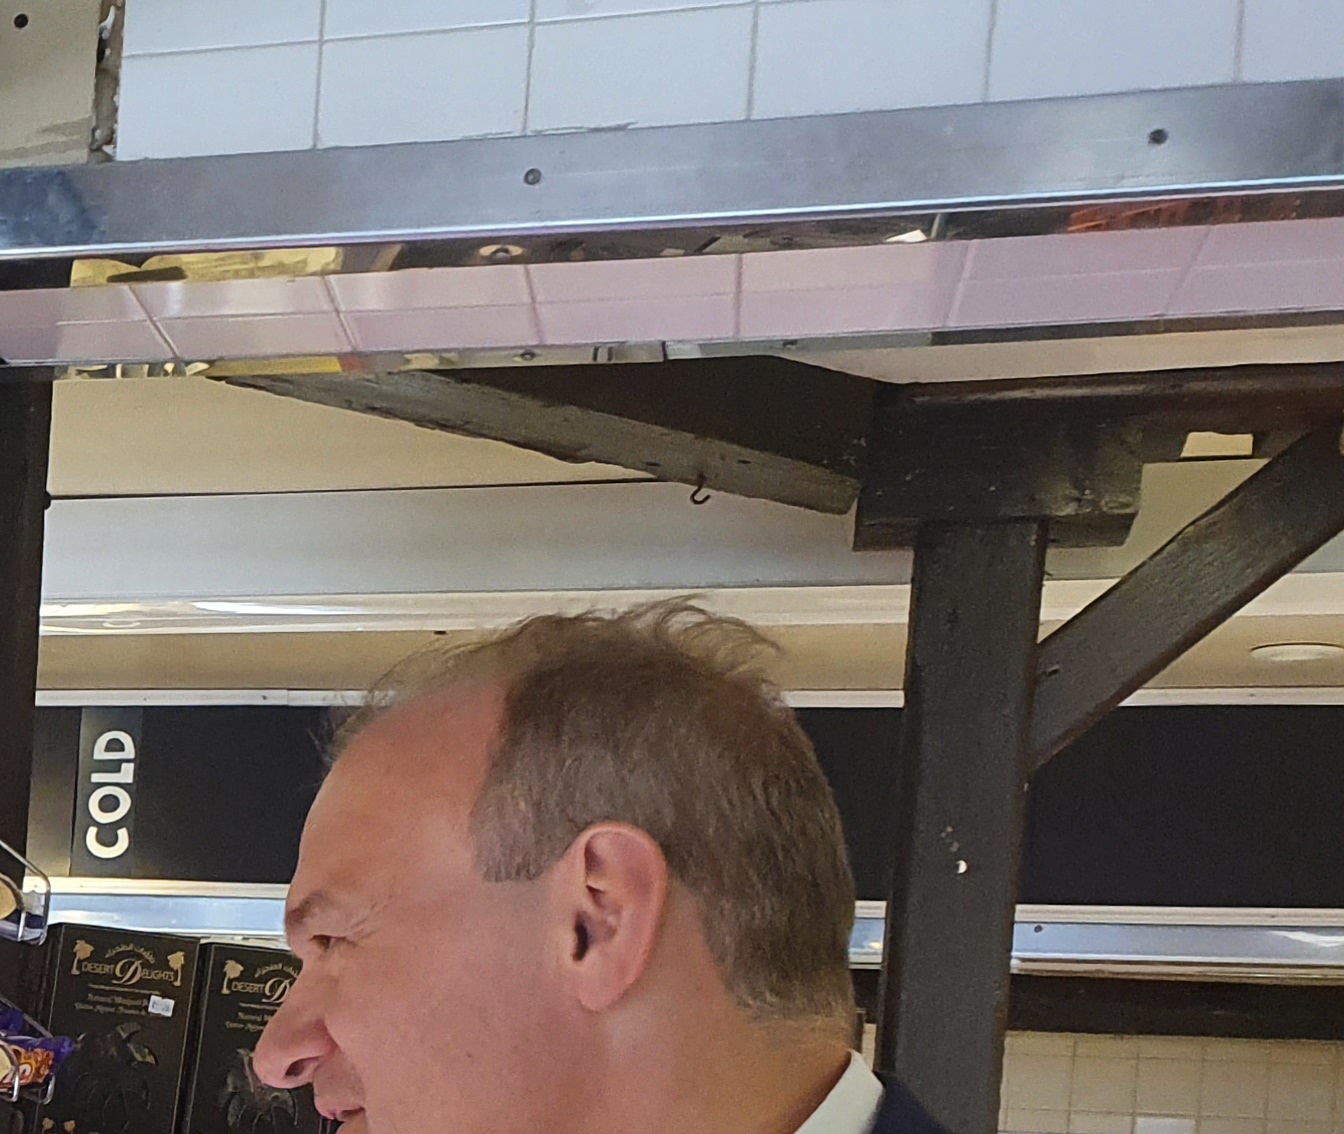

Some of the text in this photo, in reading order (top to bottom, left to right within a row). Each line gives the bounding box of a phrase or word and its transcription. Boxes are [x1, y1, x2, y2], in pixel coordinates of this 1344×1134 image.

[86, 730, 135, 859] COLD
[81, 961, 115, 976] DESERT
[231, 981, 266, 994] DESERT
